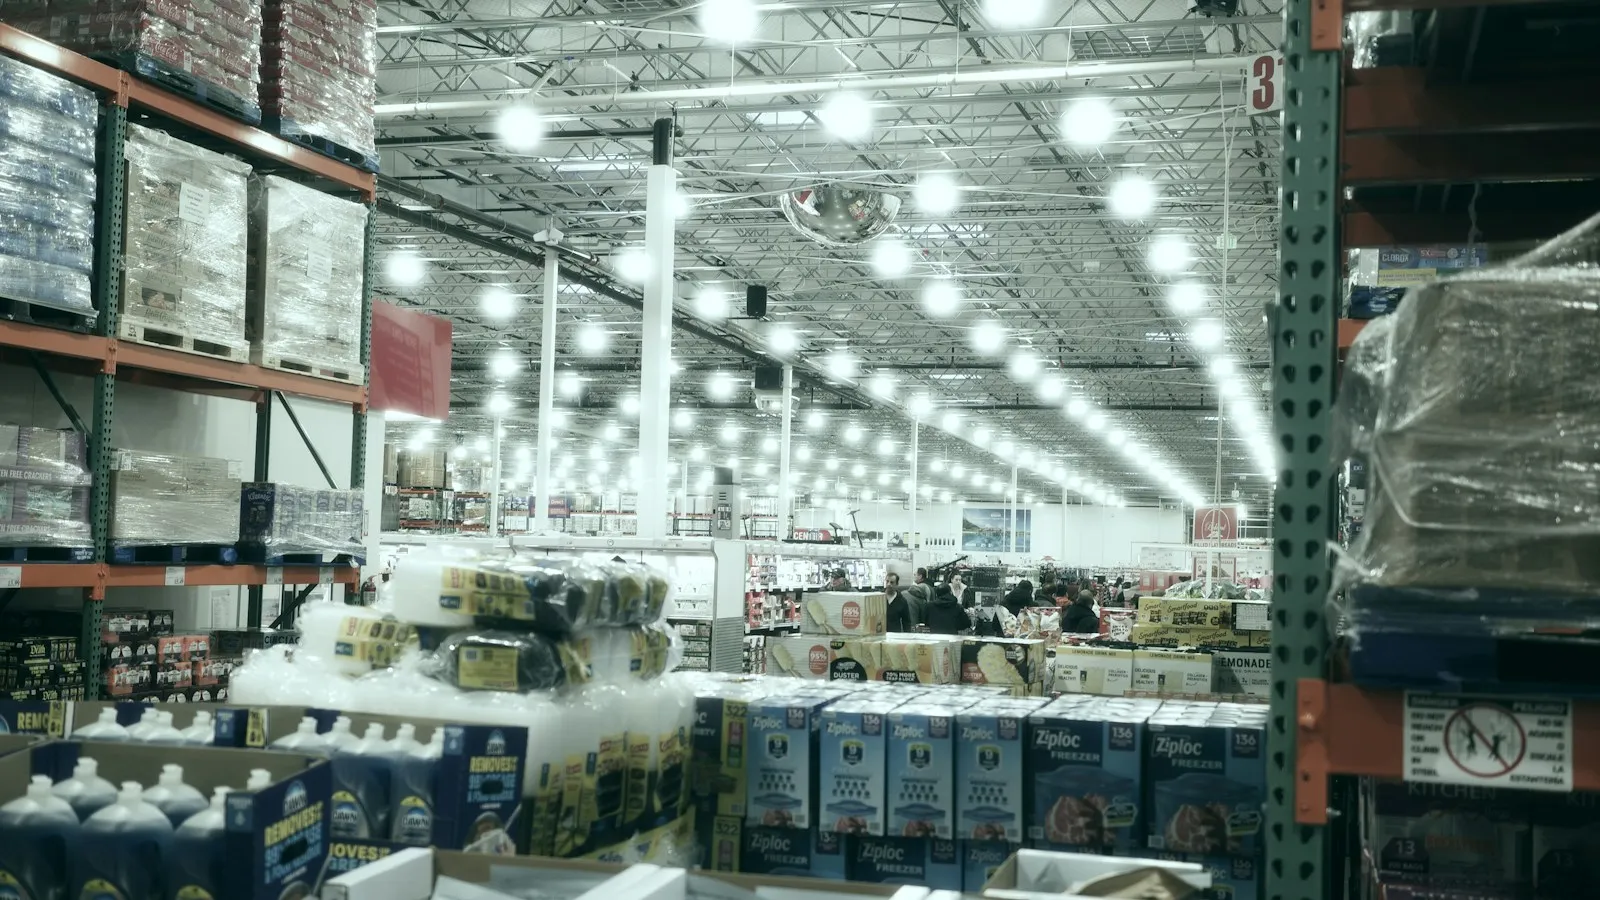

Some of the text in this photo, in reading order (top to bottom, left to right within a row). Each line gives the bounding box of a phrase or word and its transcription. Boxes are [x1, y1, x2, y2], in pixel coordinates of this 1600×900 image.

[1253, 56, 1284, 109] 3
[1382, 253, 1409, 263] CLOROX
[9, 470, 24, 480] FREE
[1144, 603, 1162, 611] Smart
[1167, 602, 1198, 613] Smartfood
[1139, 629, 1169, 640] Smartfood
[1196, 632, 1227, 642] Smartfood
[725, 704, 747, 717] 322
[752, 708, 804, 730] Ziploc 136
[826, 714, 880, 736] Ziploc 136
[894, 717, 946, 739] Ziploc 136
[962, 718, 1016, 741] Ziploc 136
[1036, 727, 1133, 749] Ziploc 136
[849, 745, 857, 755] 9
[916, 747, 924, 757] 9
[1156, 734, 1256, 757] Ziploc 136
[985, 749, 993, 758] 9
[1051, 751, 1100, 763] FREEZER
[1171, 758, 1222, 770] FREEZER
[1408, 782, 1496, 801] KITCHEN
[716, 822, 738, 835] 322
[751, 834, 791, 852] Ziploc
[1397, 840, 1415, 856] 13
[862, 843, 904, 861] Ziploc
[971, 849, 1002, 862] Ziploc
[764, 854, 807, 865] FREEZER
[876, 863, 923, 875] FREEZER
